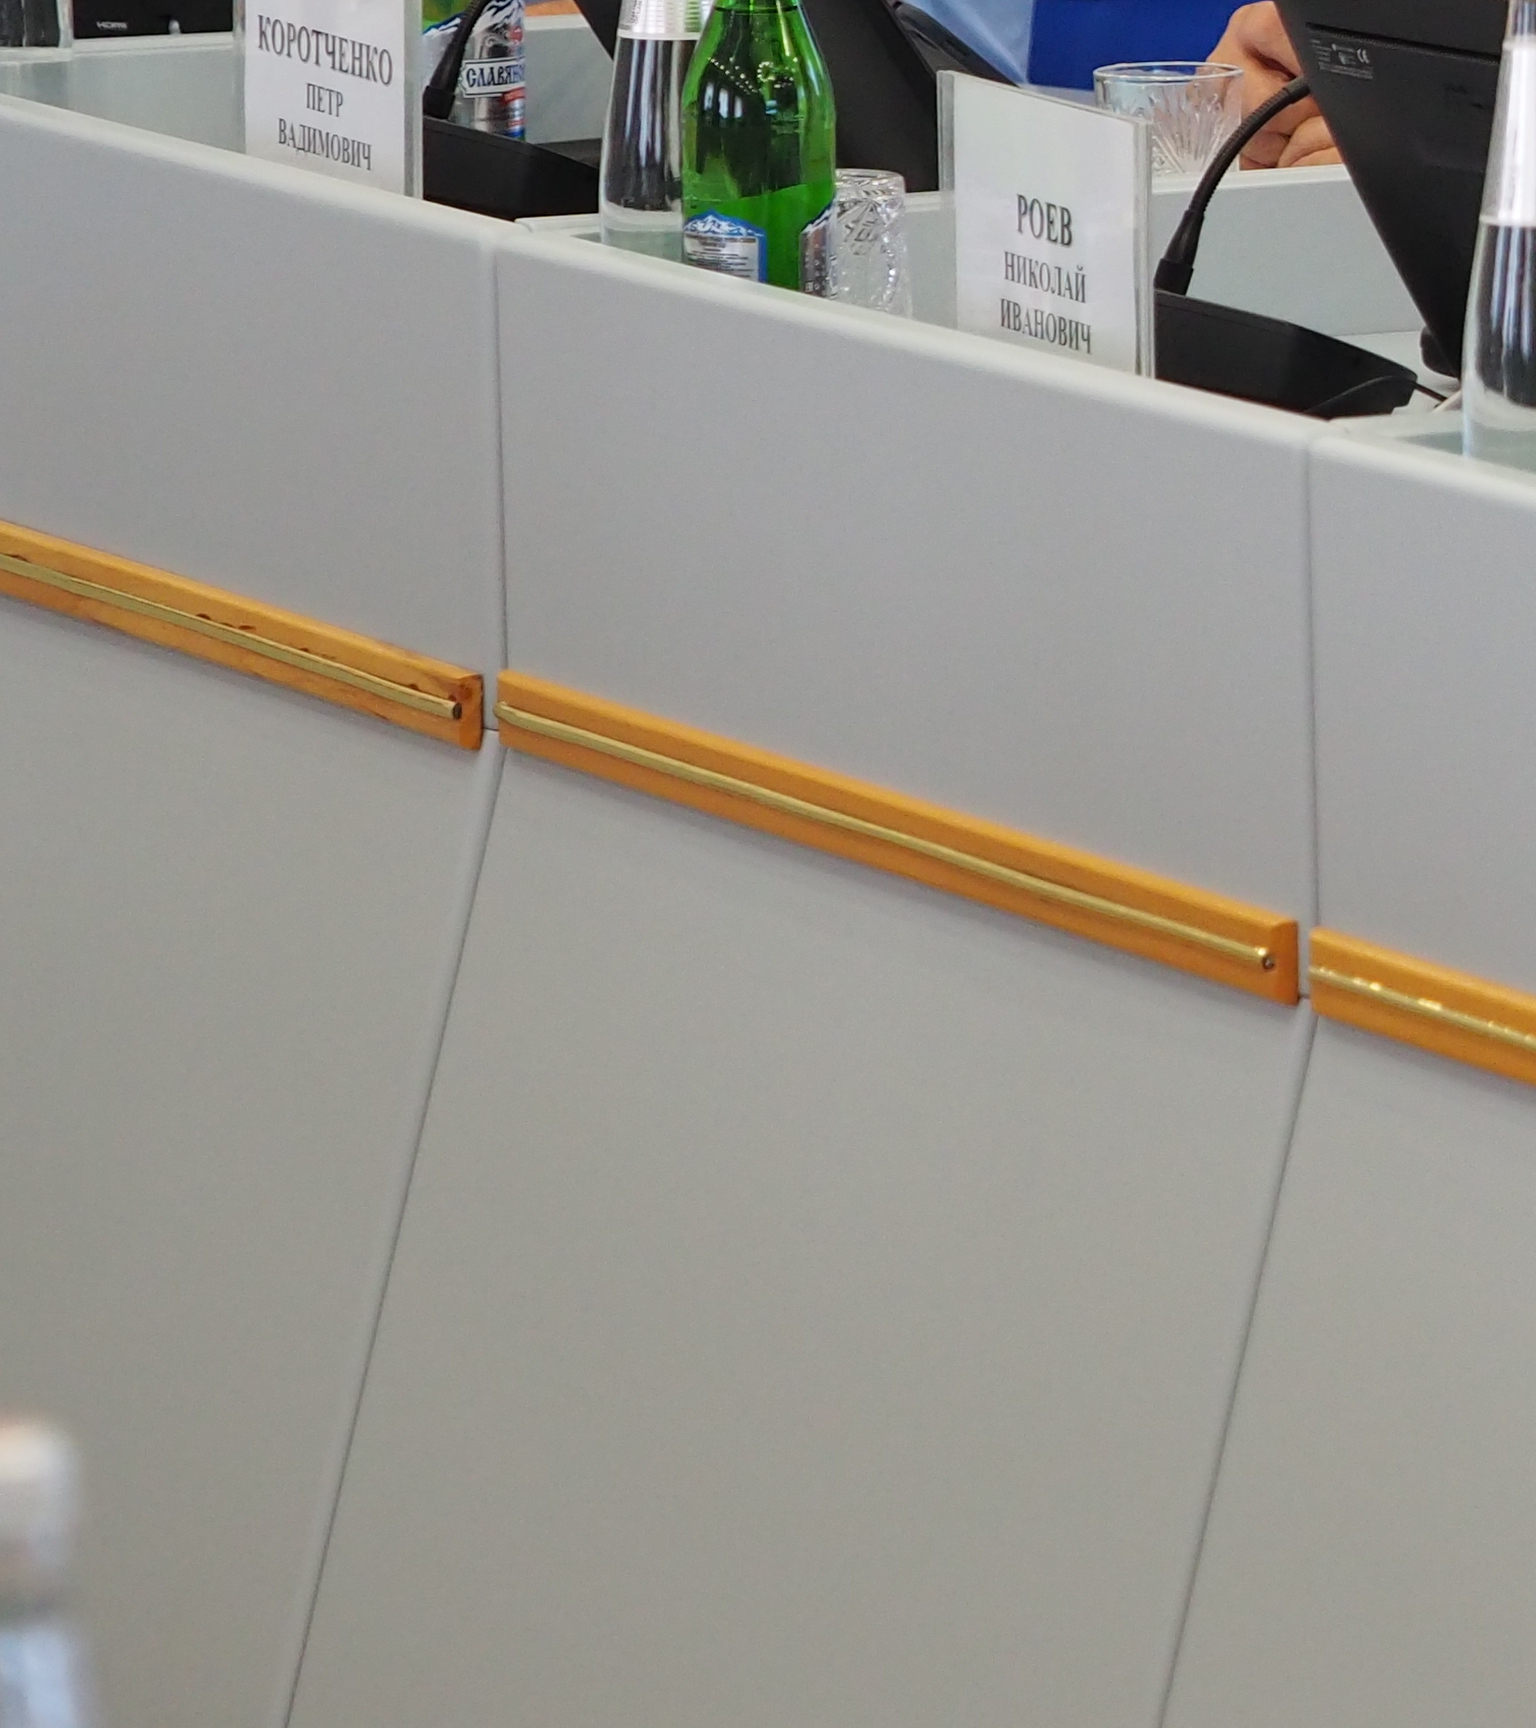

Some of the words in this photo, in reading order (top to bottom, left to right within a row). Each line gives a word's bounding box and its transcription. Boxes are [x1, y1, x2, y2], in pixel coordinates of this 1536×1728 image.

[257, 14, 393, 86] КОРОТЧЕНКО
[306, 83, 343, 117] ПЕТР
[278, 118, 372, 170] ВАДИМОВИЧ
[1017, 194, 1073, 247] РОЕВ
[1004, 251, 1086, 303] НИКОЛАЙ
[1000, 298, 1091, 354] ИВАНОВИЧ
